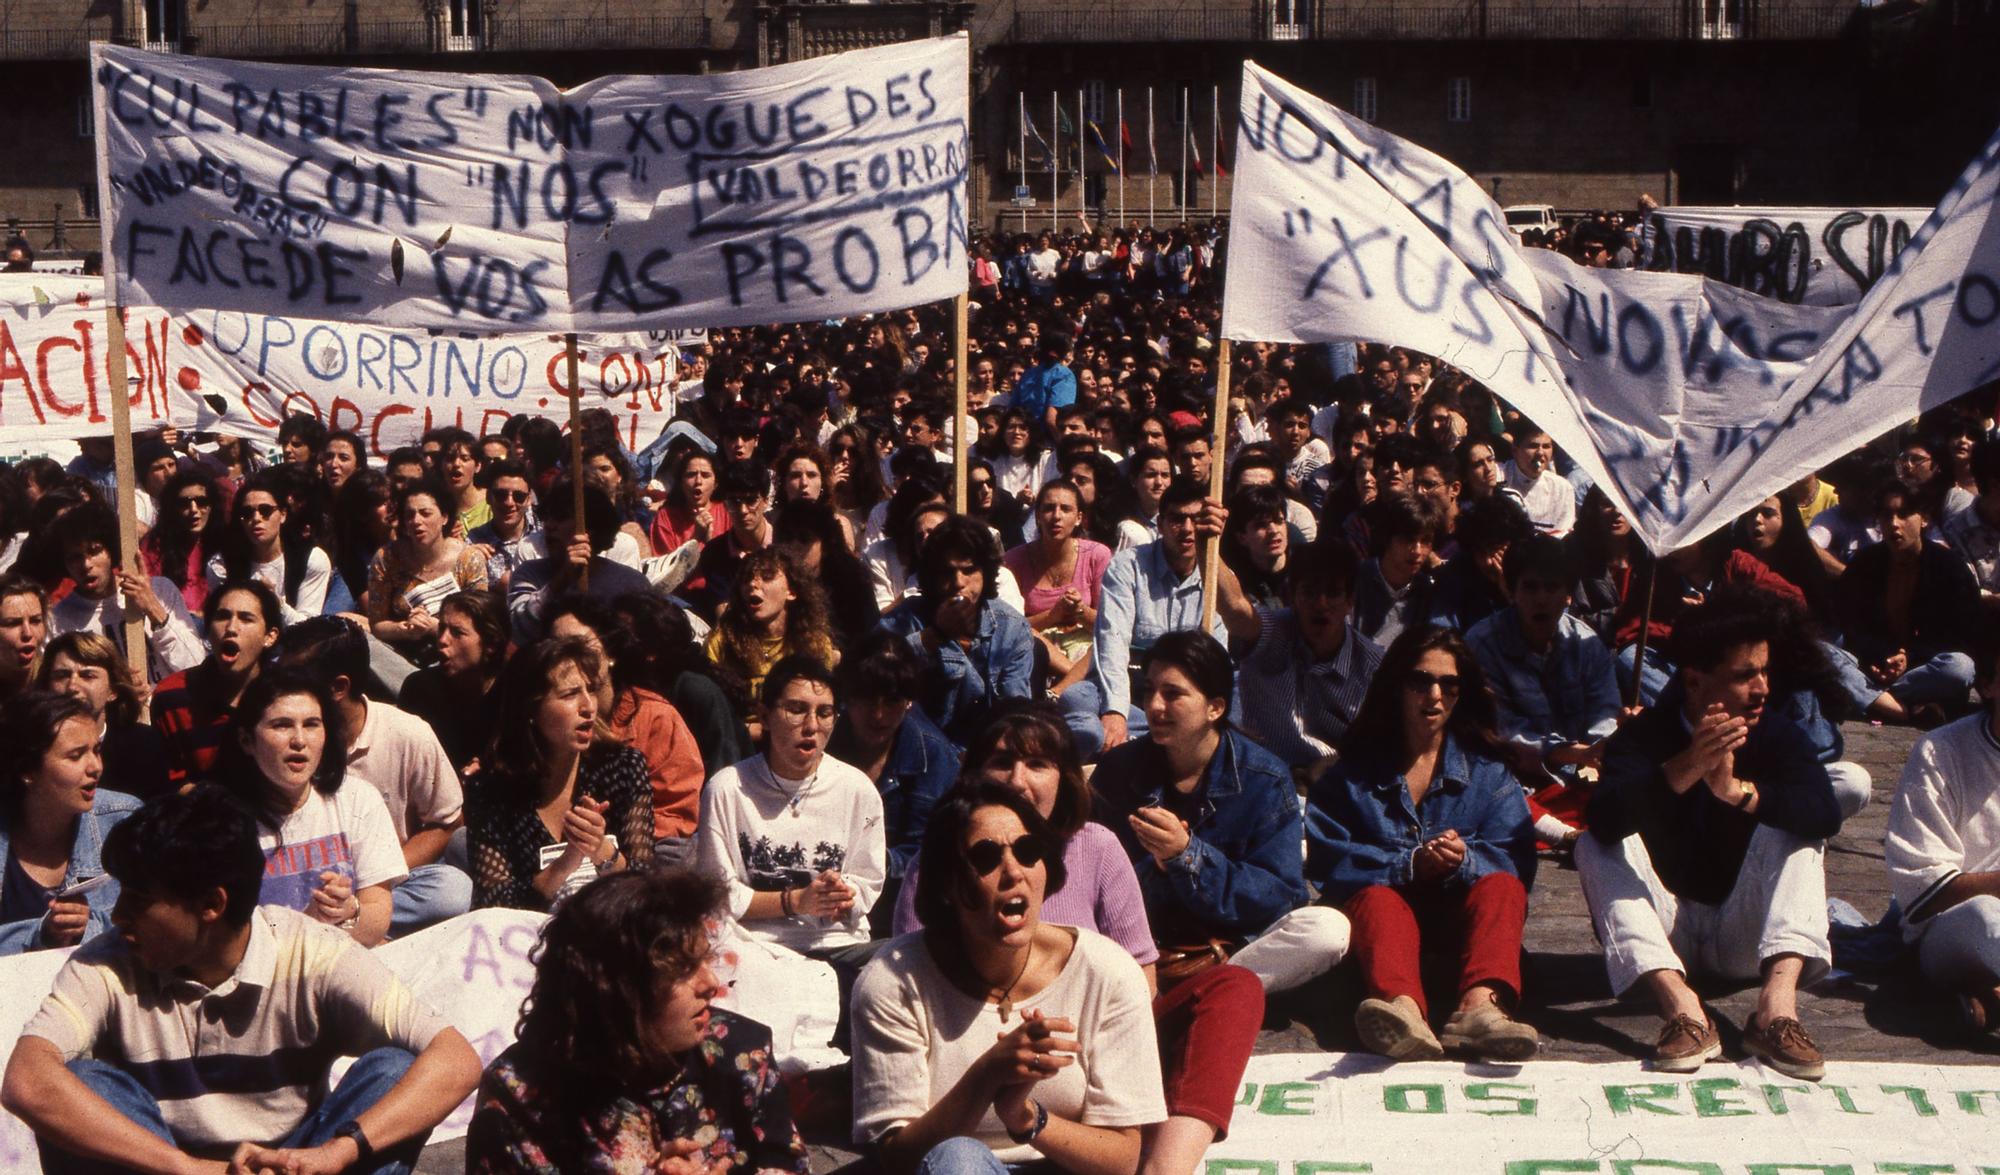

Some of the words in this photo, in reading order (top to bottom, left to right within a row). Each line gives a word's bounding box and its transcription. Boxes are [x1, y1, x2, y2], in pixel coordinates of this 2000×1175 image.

[508, 103, 593, 151] NON
[279, 155, 417, 225] CON
[467, 155, 647, 230] "NOS"
[708, 134, 967, 203] VALDEORRAS
[127, 220, 368, 304] FACEDE
[431, 249, 549, 324] VOS
[592, 248, 682, 314] AS
[1383, 1081, 1538, 1117] OS
